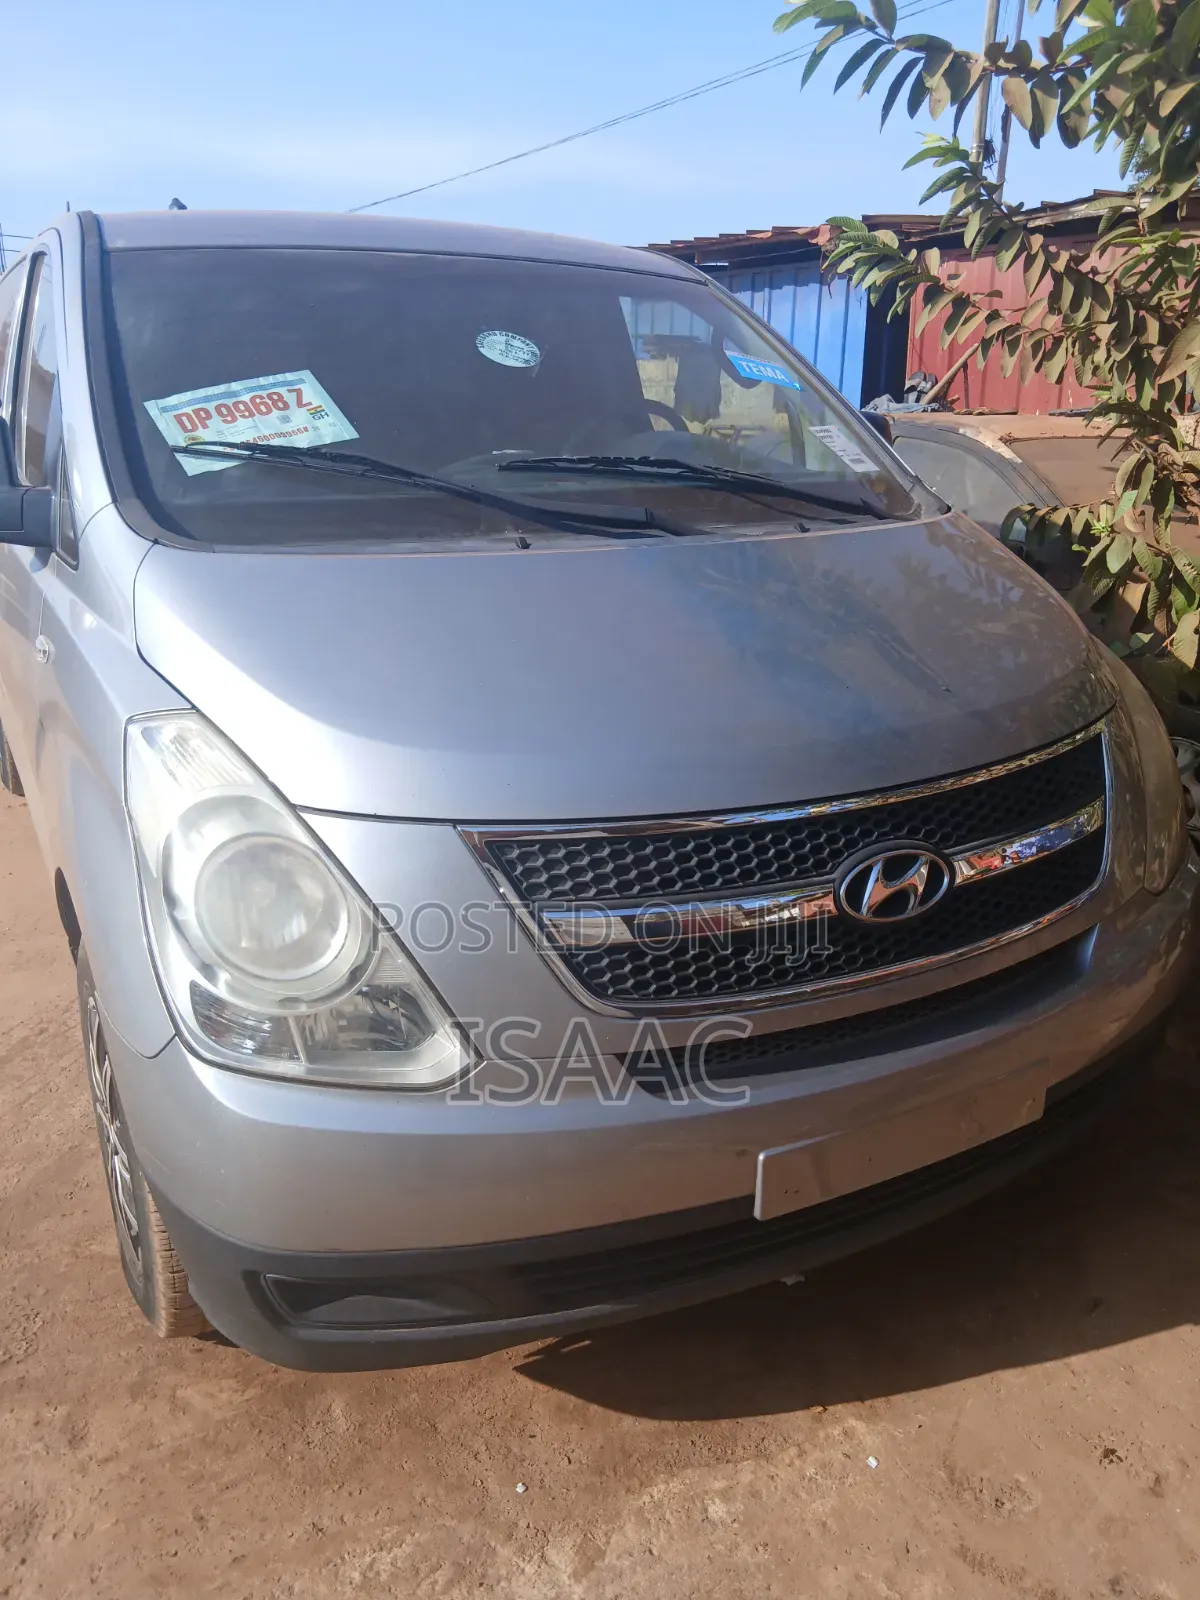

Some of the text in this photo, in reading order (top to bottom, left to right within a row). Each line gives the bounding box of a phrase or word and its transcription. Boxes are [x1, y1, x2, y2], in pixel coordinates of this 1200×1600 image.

[737, 360, 791, 384] TEMA
[173, 407, 213, 433] DP
[214, 391, 291, 425] 9968
[287, 387, 313, 409] Z
[312, 411, 330, 421] GH
